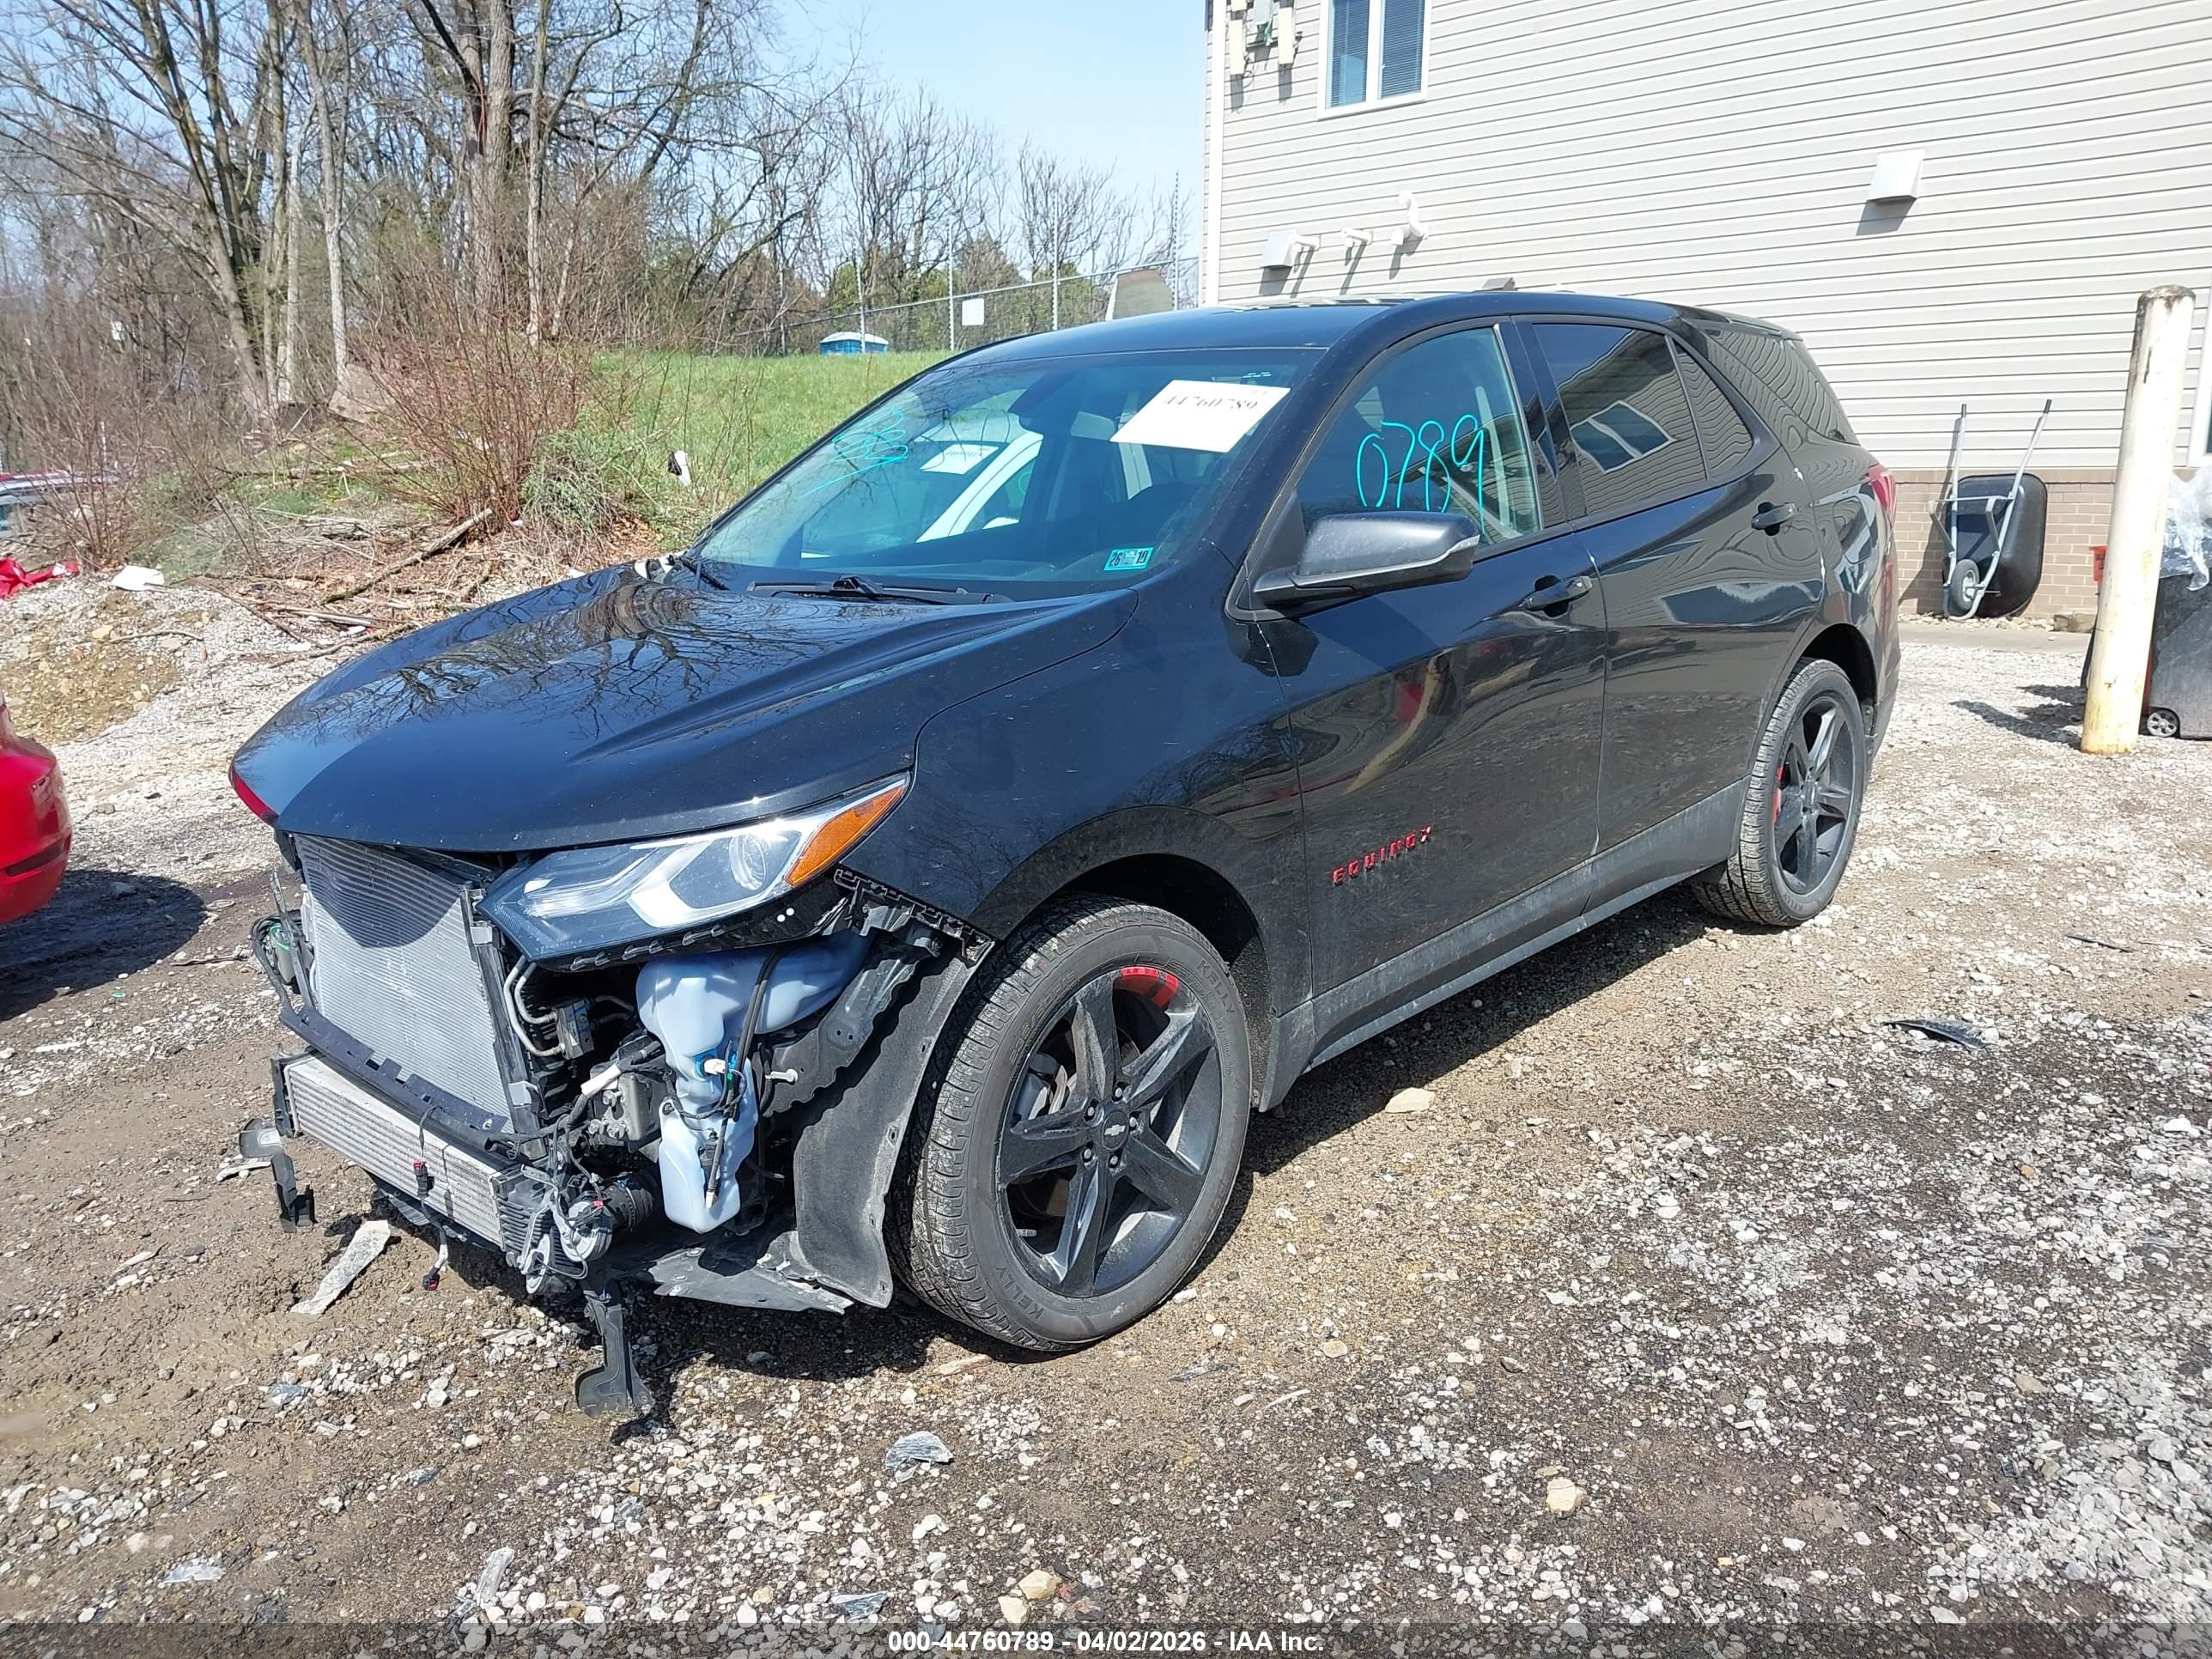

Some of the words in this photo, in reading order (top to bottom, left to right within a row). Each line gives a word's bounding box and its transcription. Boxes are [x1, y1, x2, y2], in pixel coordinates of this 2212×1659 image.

[1356, 414, 1485, 534] 0789
[1136, 550, 1149, 564] 10
[1332, 825, 1431, 885] EQUINOX
[1197, 959, 1237, 1013] KELLY
[996, 1266, 1045, 1320] KELLY
